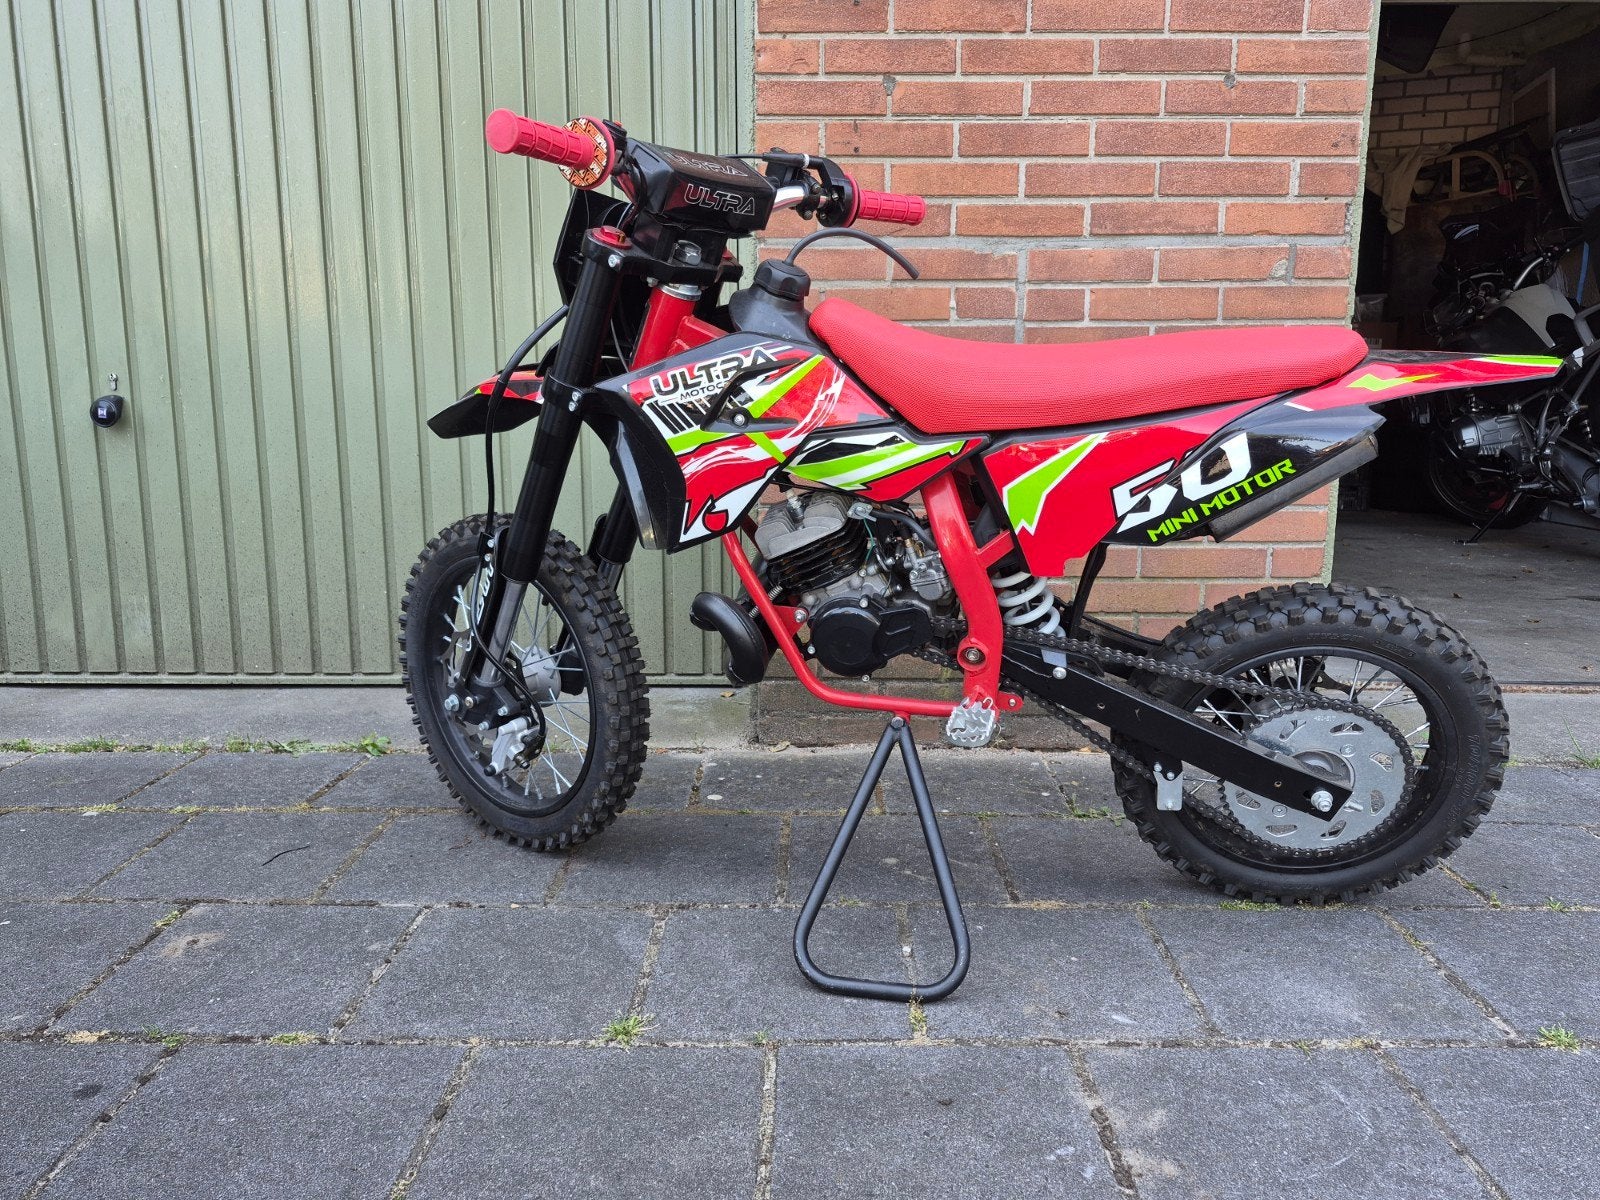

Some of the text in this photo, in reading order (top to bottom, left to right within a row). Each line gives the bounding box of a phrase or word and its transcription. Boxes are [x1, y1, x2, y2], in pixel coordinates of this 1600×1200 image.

[684, 183, 755, 216] ULTRA
[650, 347, 775, 397] ULTRA
[1112, 432, 1252, 534] 50
[1147, 458, 1296, 542] MINI MOTOR
